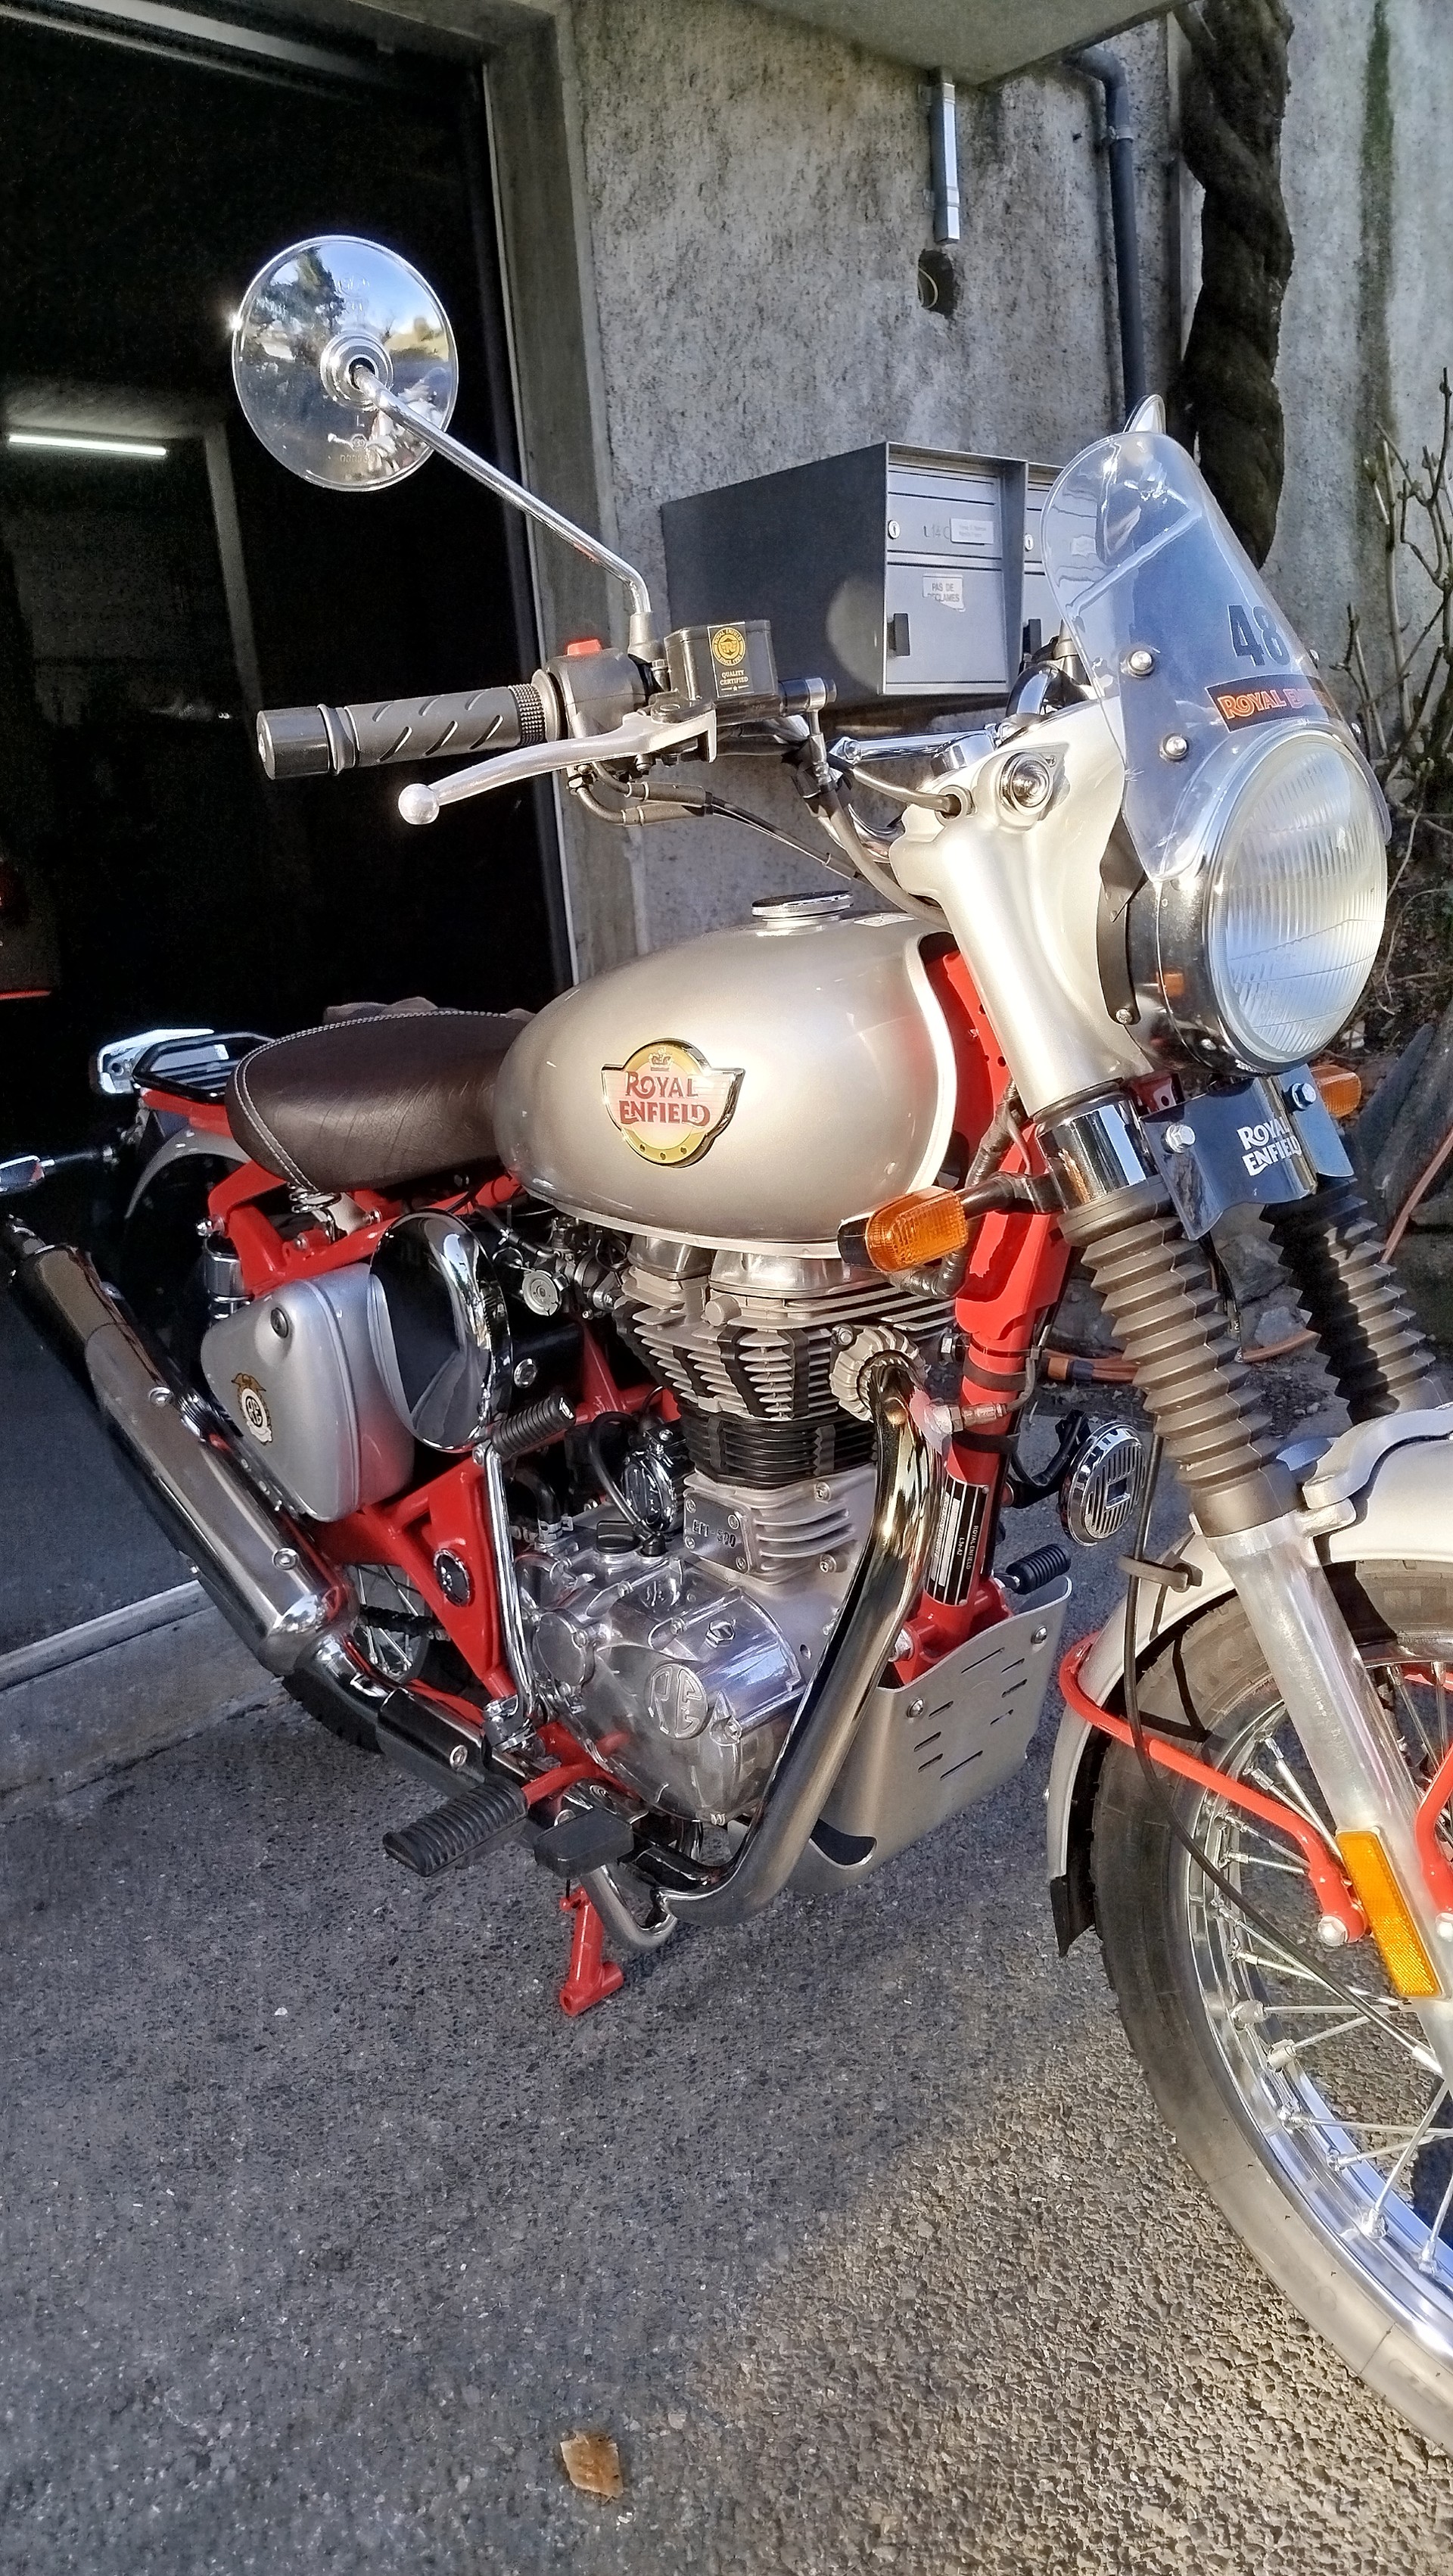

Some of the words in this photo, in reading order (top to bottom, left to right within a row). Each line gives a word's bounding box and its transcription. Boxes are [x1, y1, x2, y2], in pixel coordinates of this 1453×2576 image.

[932, 583, 943, 591] PAS
[1227, 604, 1290, 667] 48
[720, 676, 748, 686] CERTIFIED
[721, 669, 745, 679] QUALITY
[1218, 689, 1287, 720] ROYAL
[625, 1071, 698, 1100] ROYAL
[618, 1100, 711, 1127] ENFIELD
[1237, 1116, 1290, 1150] ROYAL
[1242, 1135, 1302, 1176] ENFIELD
[970, 1525, 979, 1545] ROYAL
[966, 1545, 975, 1570] ENFIELD
